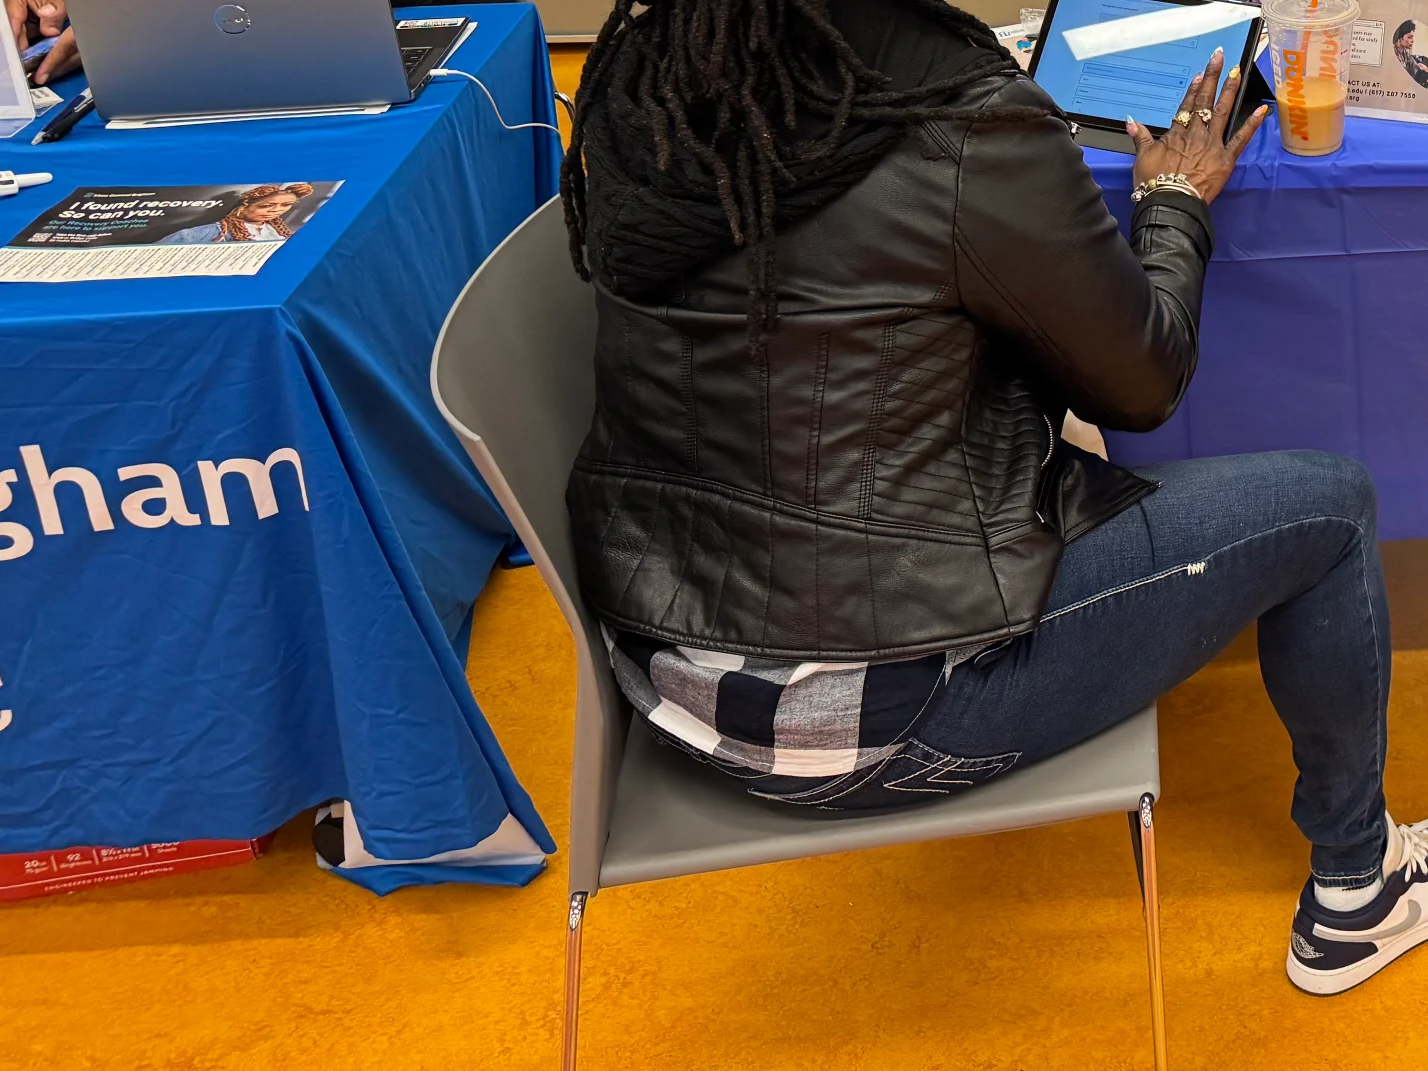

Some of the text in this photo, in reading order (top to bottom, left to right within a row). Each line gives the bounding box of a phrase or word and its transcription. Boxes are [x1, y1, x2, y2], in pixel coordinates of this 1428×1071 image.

[1368, 89, 1385, 97] (617)
[69, 199, 224, 210] I found recovery.
[58, 209, 165, 220] So can you.
